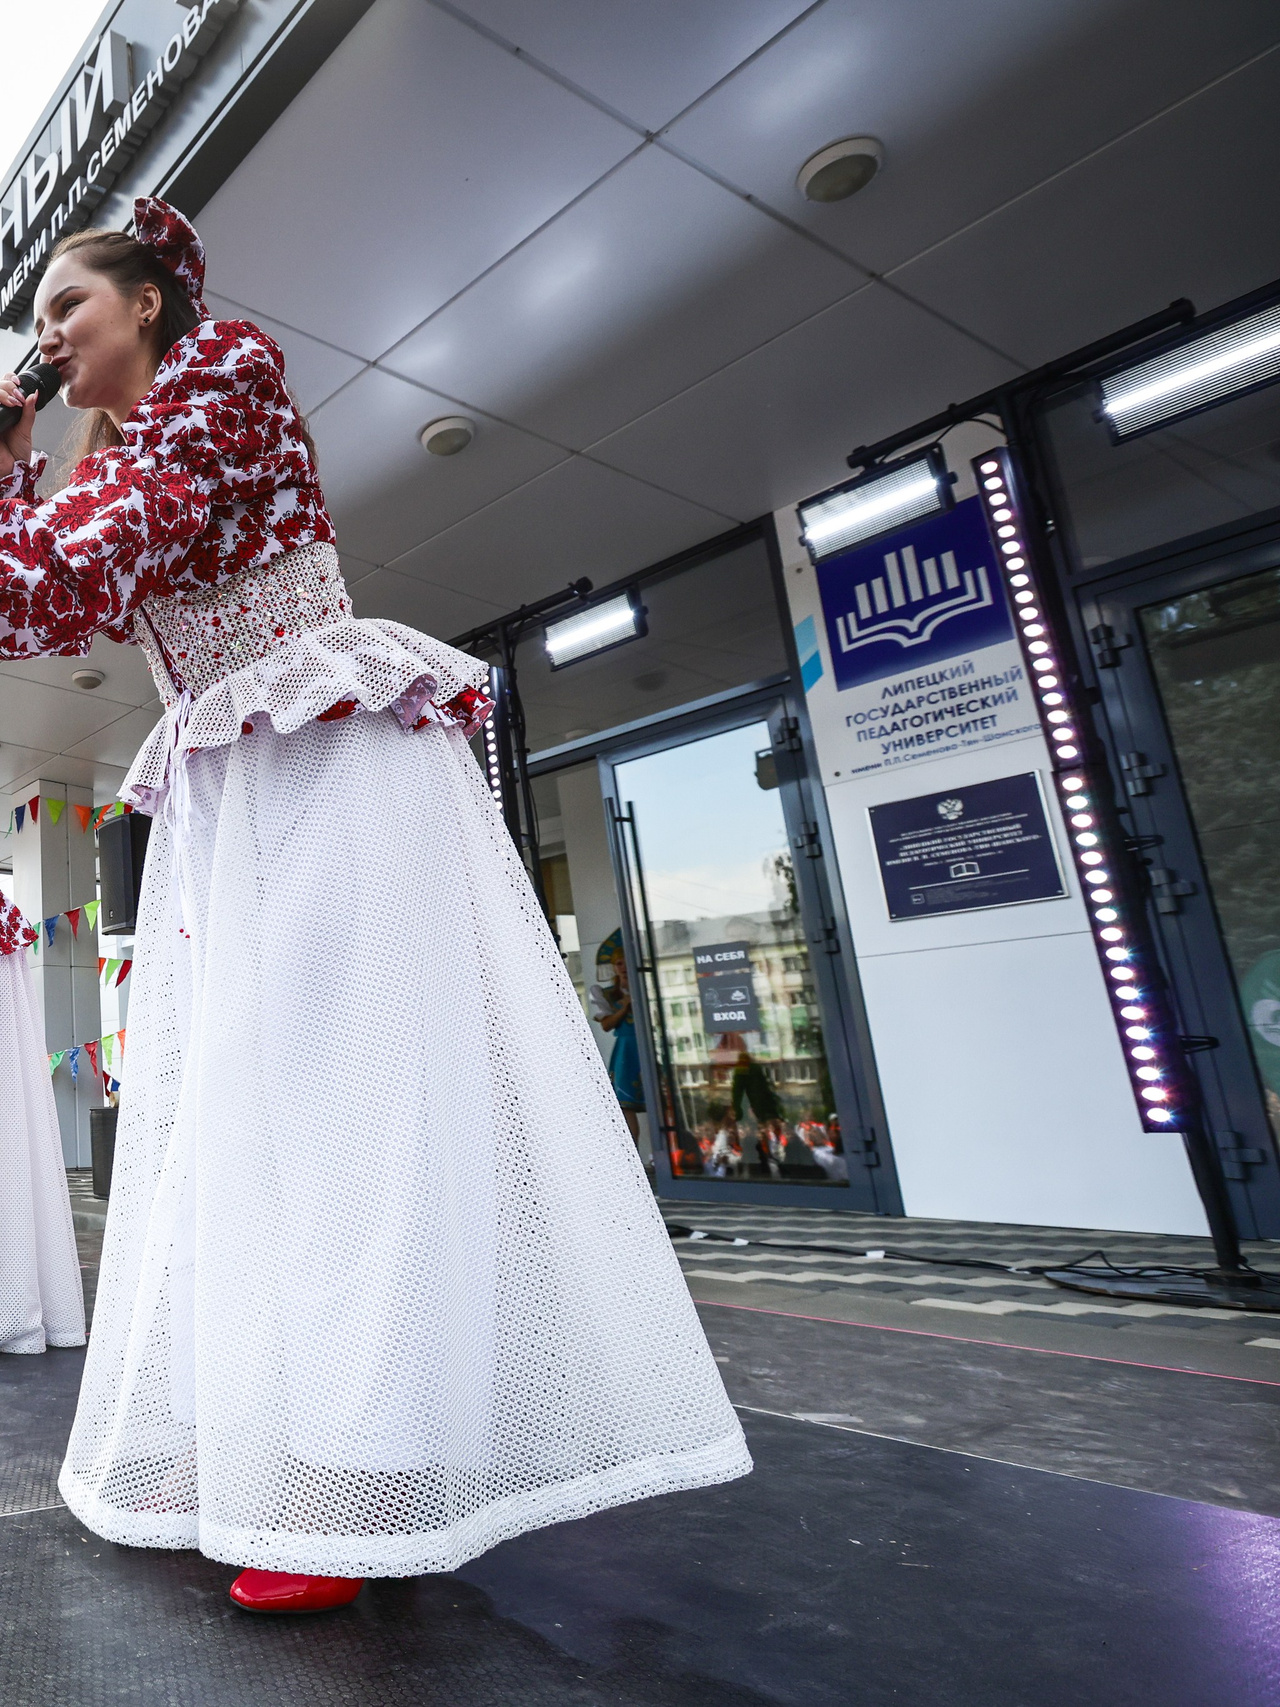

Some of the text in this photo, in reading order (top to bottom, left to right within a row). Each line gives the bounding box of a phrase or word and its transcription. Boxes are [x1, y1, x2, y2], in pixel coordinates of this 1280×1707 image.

[845, 665, 1024, 727] ГОСУДАРСТВЕННЫЙ
[881, 660, 975, 699] ЛИПЕЦКИЙ
[857, 687, 1019, 742] ПЕДАГОГИЧЕСКИЙ
[881, 714, 998, 755] УНИВЕРСИТЕТ
[697, 950, 745, 964] НА СЕБЯ
[713, 1011, 746, 1021] ВХОД
